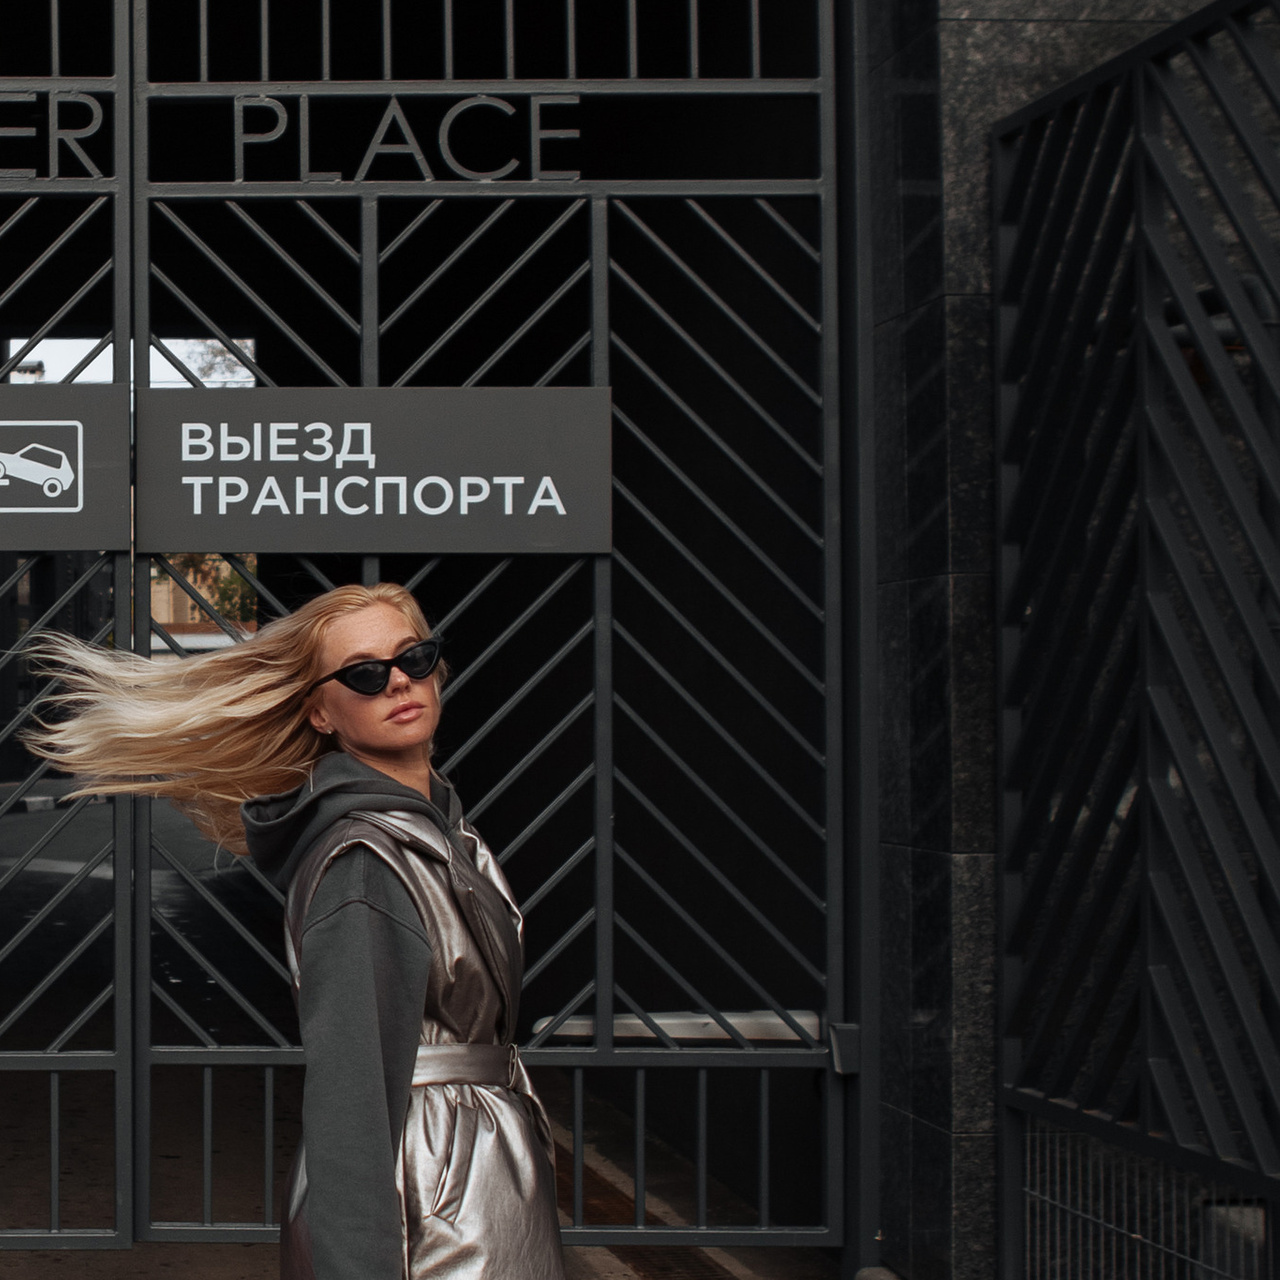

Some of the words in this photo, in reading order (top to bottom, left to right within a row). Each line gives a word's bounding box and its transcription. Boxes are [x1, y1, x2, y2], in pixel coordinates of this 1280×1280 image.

[233, 94, 583, 183] PLACE
[180, 422, 376, 468] ВЫЕЗД
[182, 475, 567, 516] ТРАНСПОРТА
